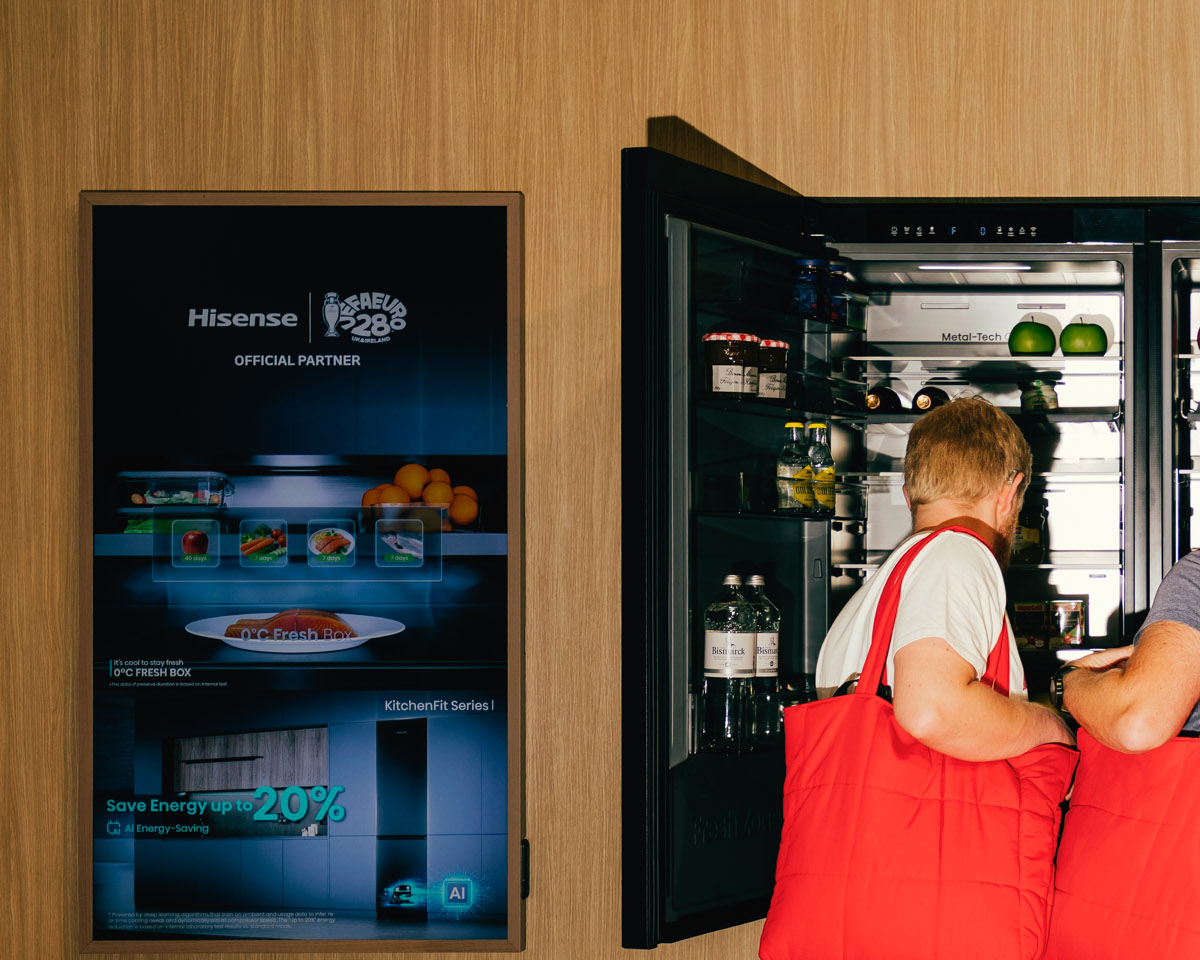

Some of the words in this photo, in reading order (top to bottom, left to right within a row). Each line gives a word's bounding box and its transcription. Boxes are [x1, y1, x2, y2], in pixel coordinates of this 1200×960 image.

[188, 308, 298, 327] Hisense
[942, 332, 1002, 341] Metal-Tech
[234, 354, 295, 366] OFFICIAL
[298, 354, 360, 366] PARTNER
[240, 628, 268, 641] 0°C
[274, 628, 318, 640] Fresh
[324, 628, 352, 641] Box
[136, 668, 167, 677] FRESH
[170, 668, 191, 677] BOX
[384, 700, 448, 711] KitchenFit
[450, 700, 489, 711] Series
[106, 799, 146, 812] Save
[150, 799, 207, 816] Energy
[211, 801, 234, 816] up
[236, 800, 253, 812] to
[125, 824, 134, 832] AI
[137, 824, 209, 834] Energy-Saving
[449, 886, 465, 900] AI
